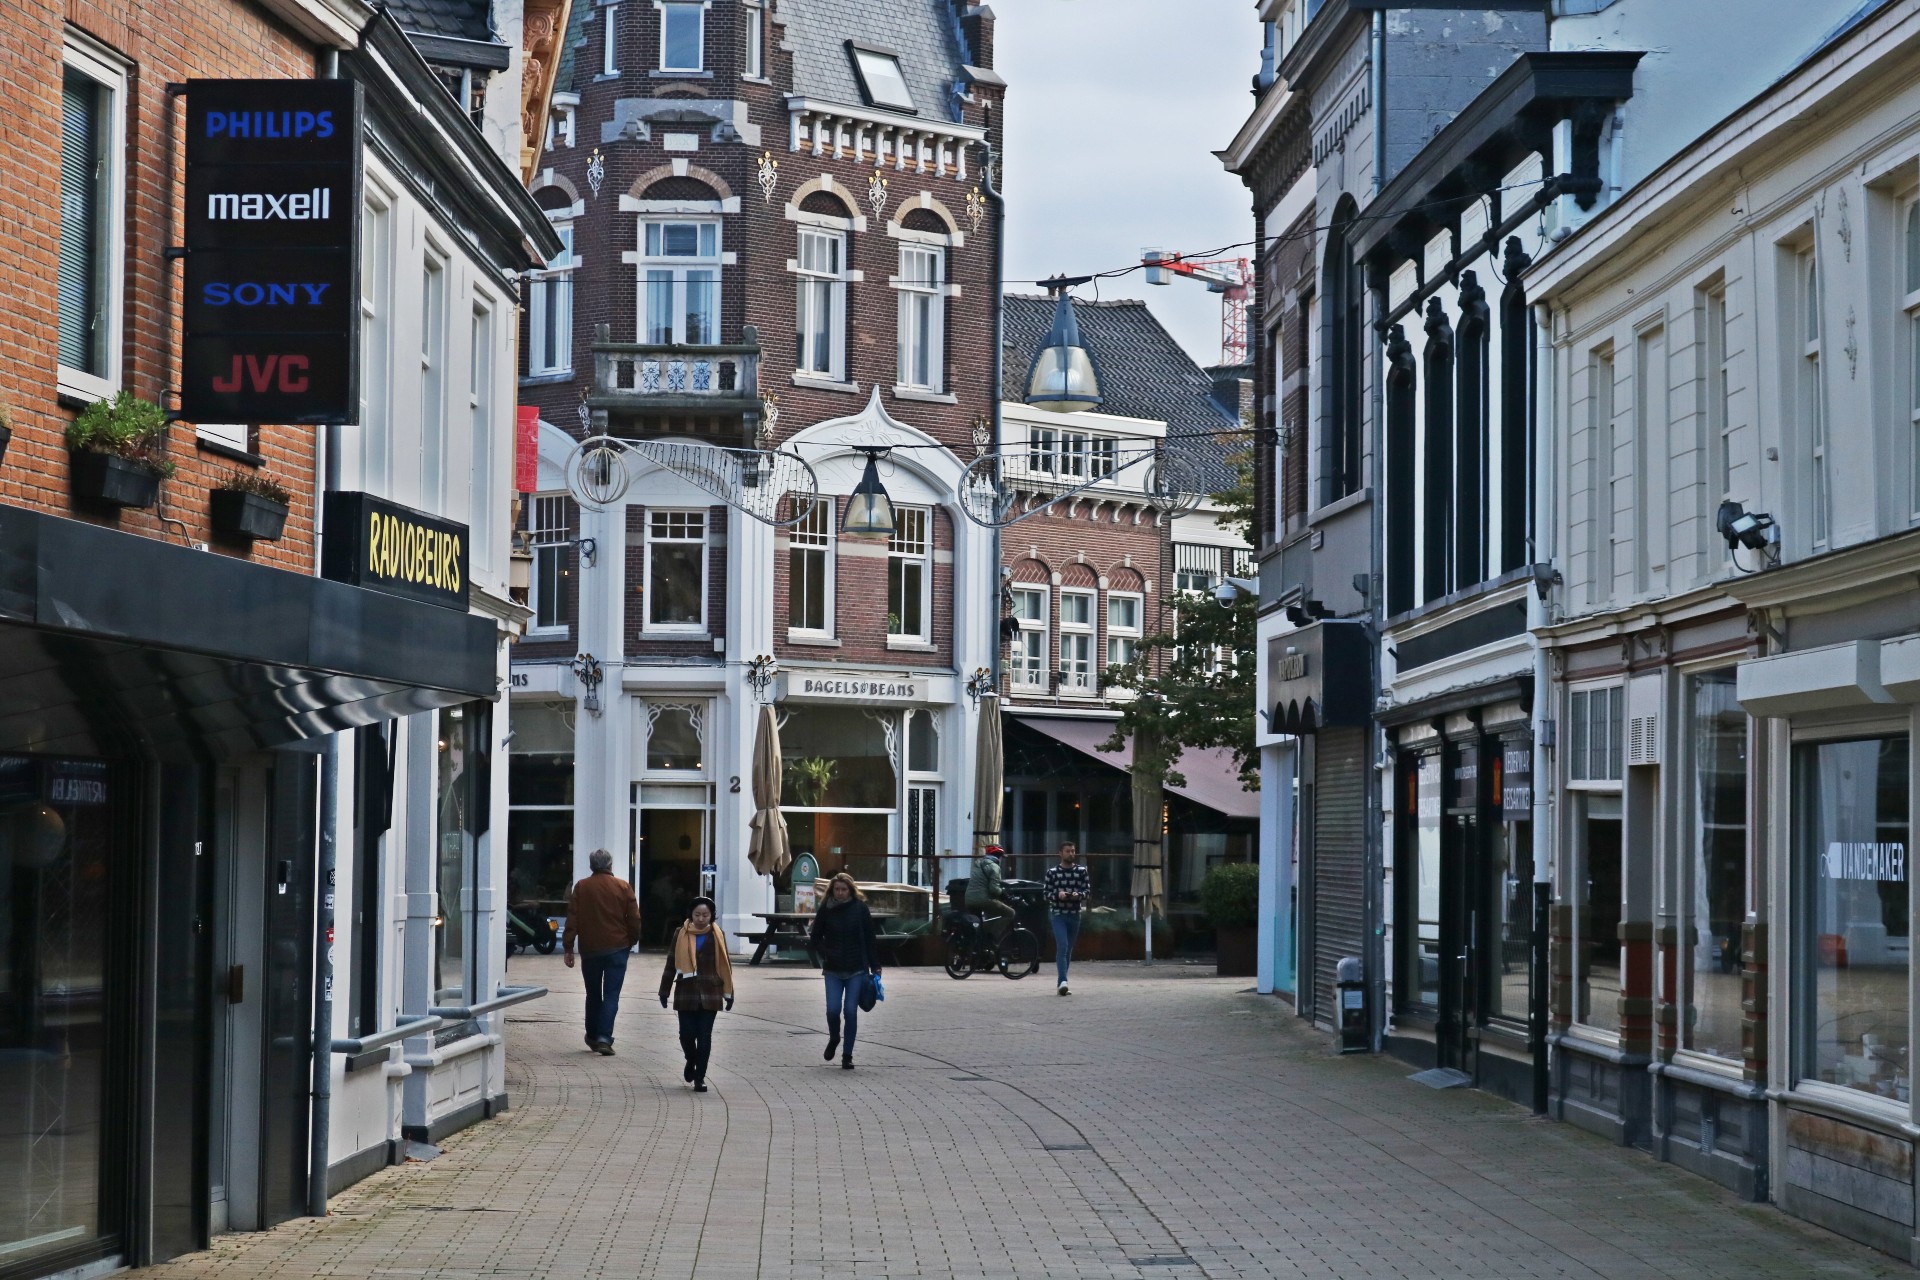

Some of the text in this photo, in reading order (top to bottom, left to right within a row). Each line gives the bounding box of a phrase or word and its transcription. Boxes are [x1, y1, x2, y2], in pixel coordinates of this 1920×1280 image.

[206, 111, 334, 138] PHILIPS
[208, 187, 330, 220] maxell
[203, 282, 331, 306] SONY
[212, 354, 309, 393] JVC
[369, 511, 461, 594] RADIOBEURS
[804, 679, 859, 694] BAGELS
[869, 683, 915, 697] BEANS
[729, 775, 741, 793] 2
[1842, 842, 1904, 881] VANDEMAKER
